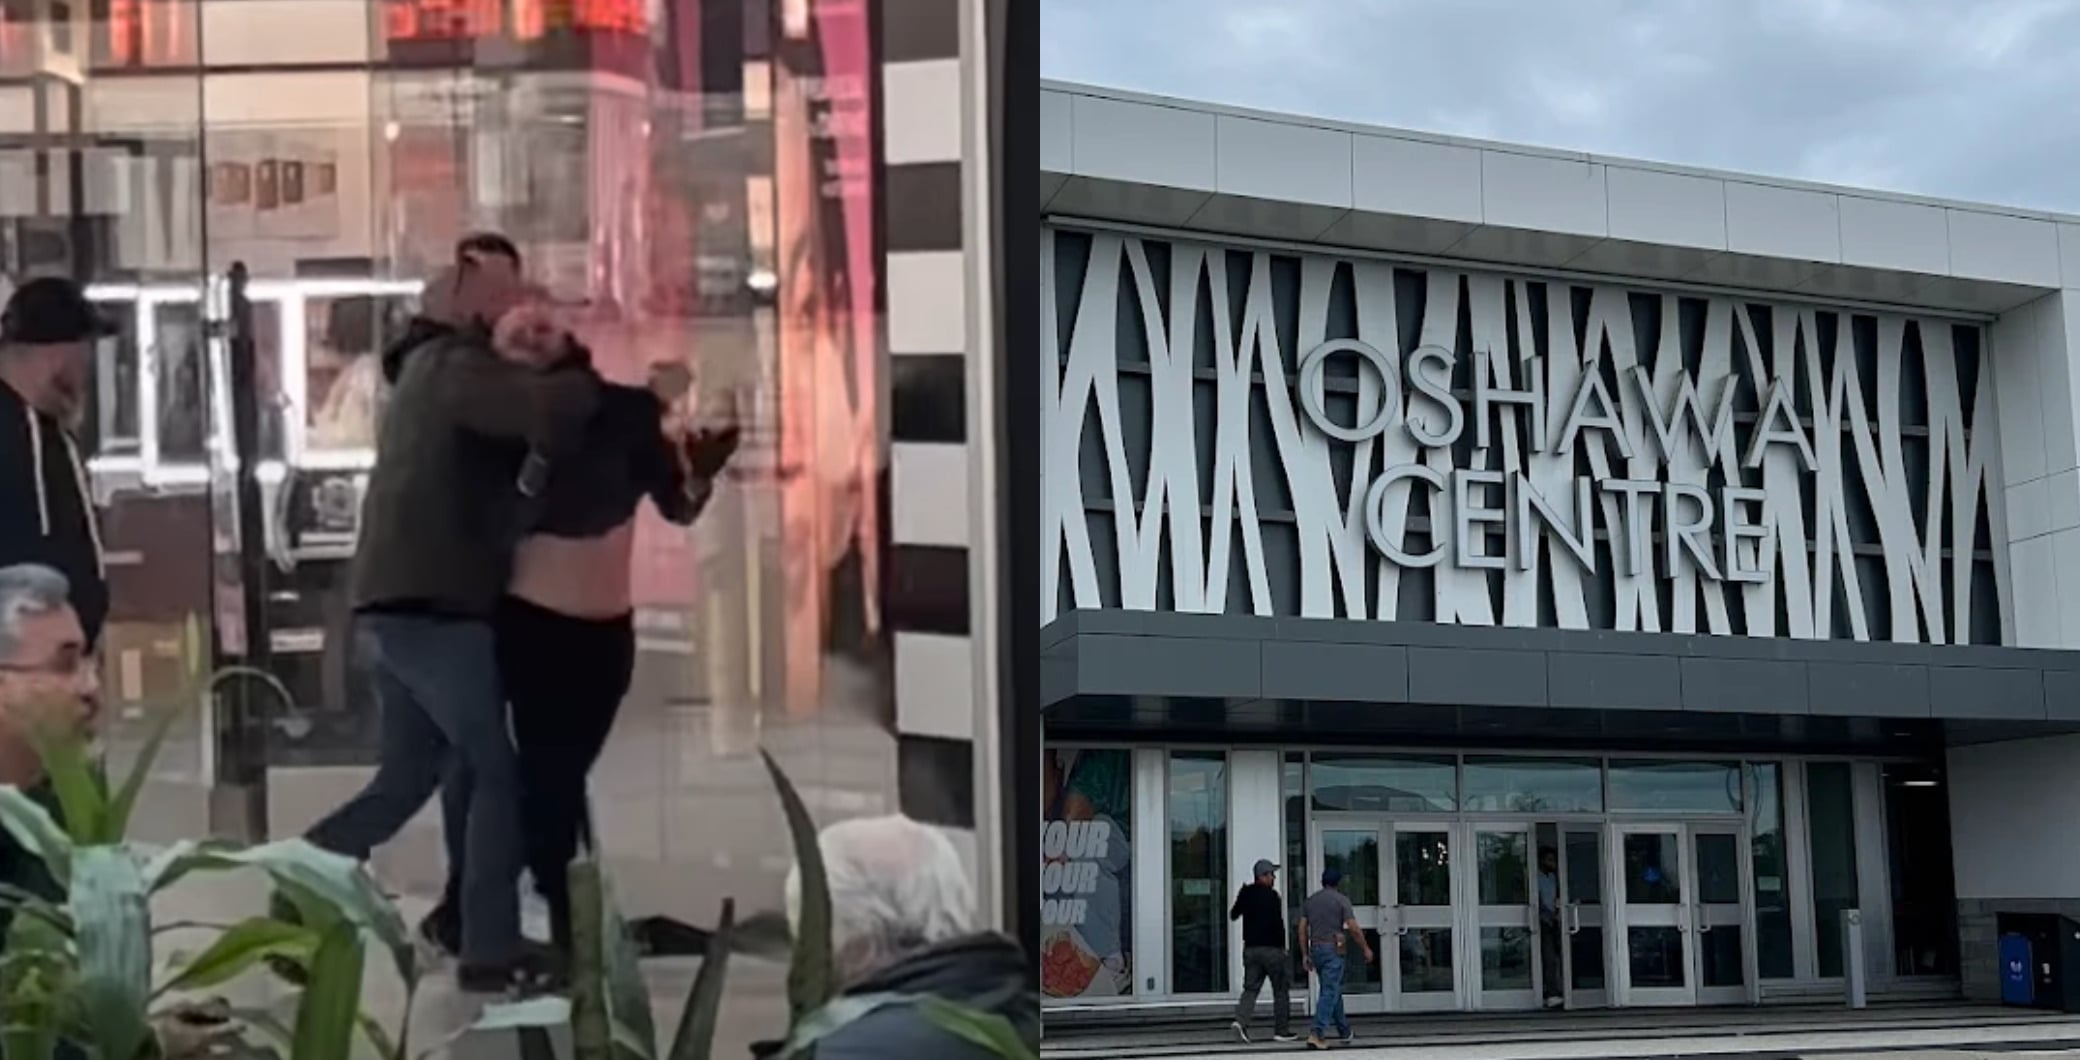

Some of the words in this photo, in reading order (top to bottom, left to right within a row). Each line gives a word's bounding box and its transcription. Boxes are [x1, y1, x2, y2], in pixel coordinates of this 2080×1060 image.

[1298, 338, 1819, 472] OSHAWA
[1365, 463, 1770, 583] CENTRE
[1043, 821, 1110, 858] OUR
[1043, 862, 1098, 893] OUR
[1041, 899, 1087, 924] OUR
